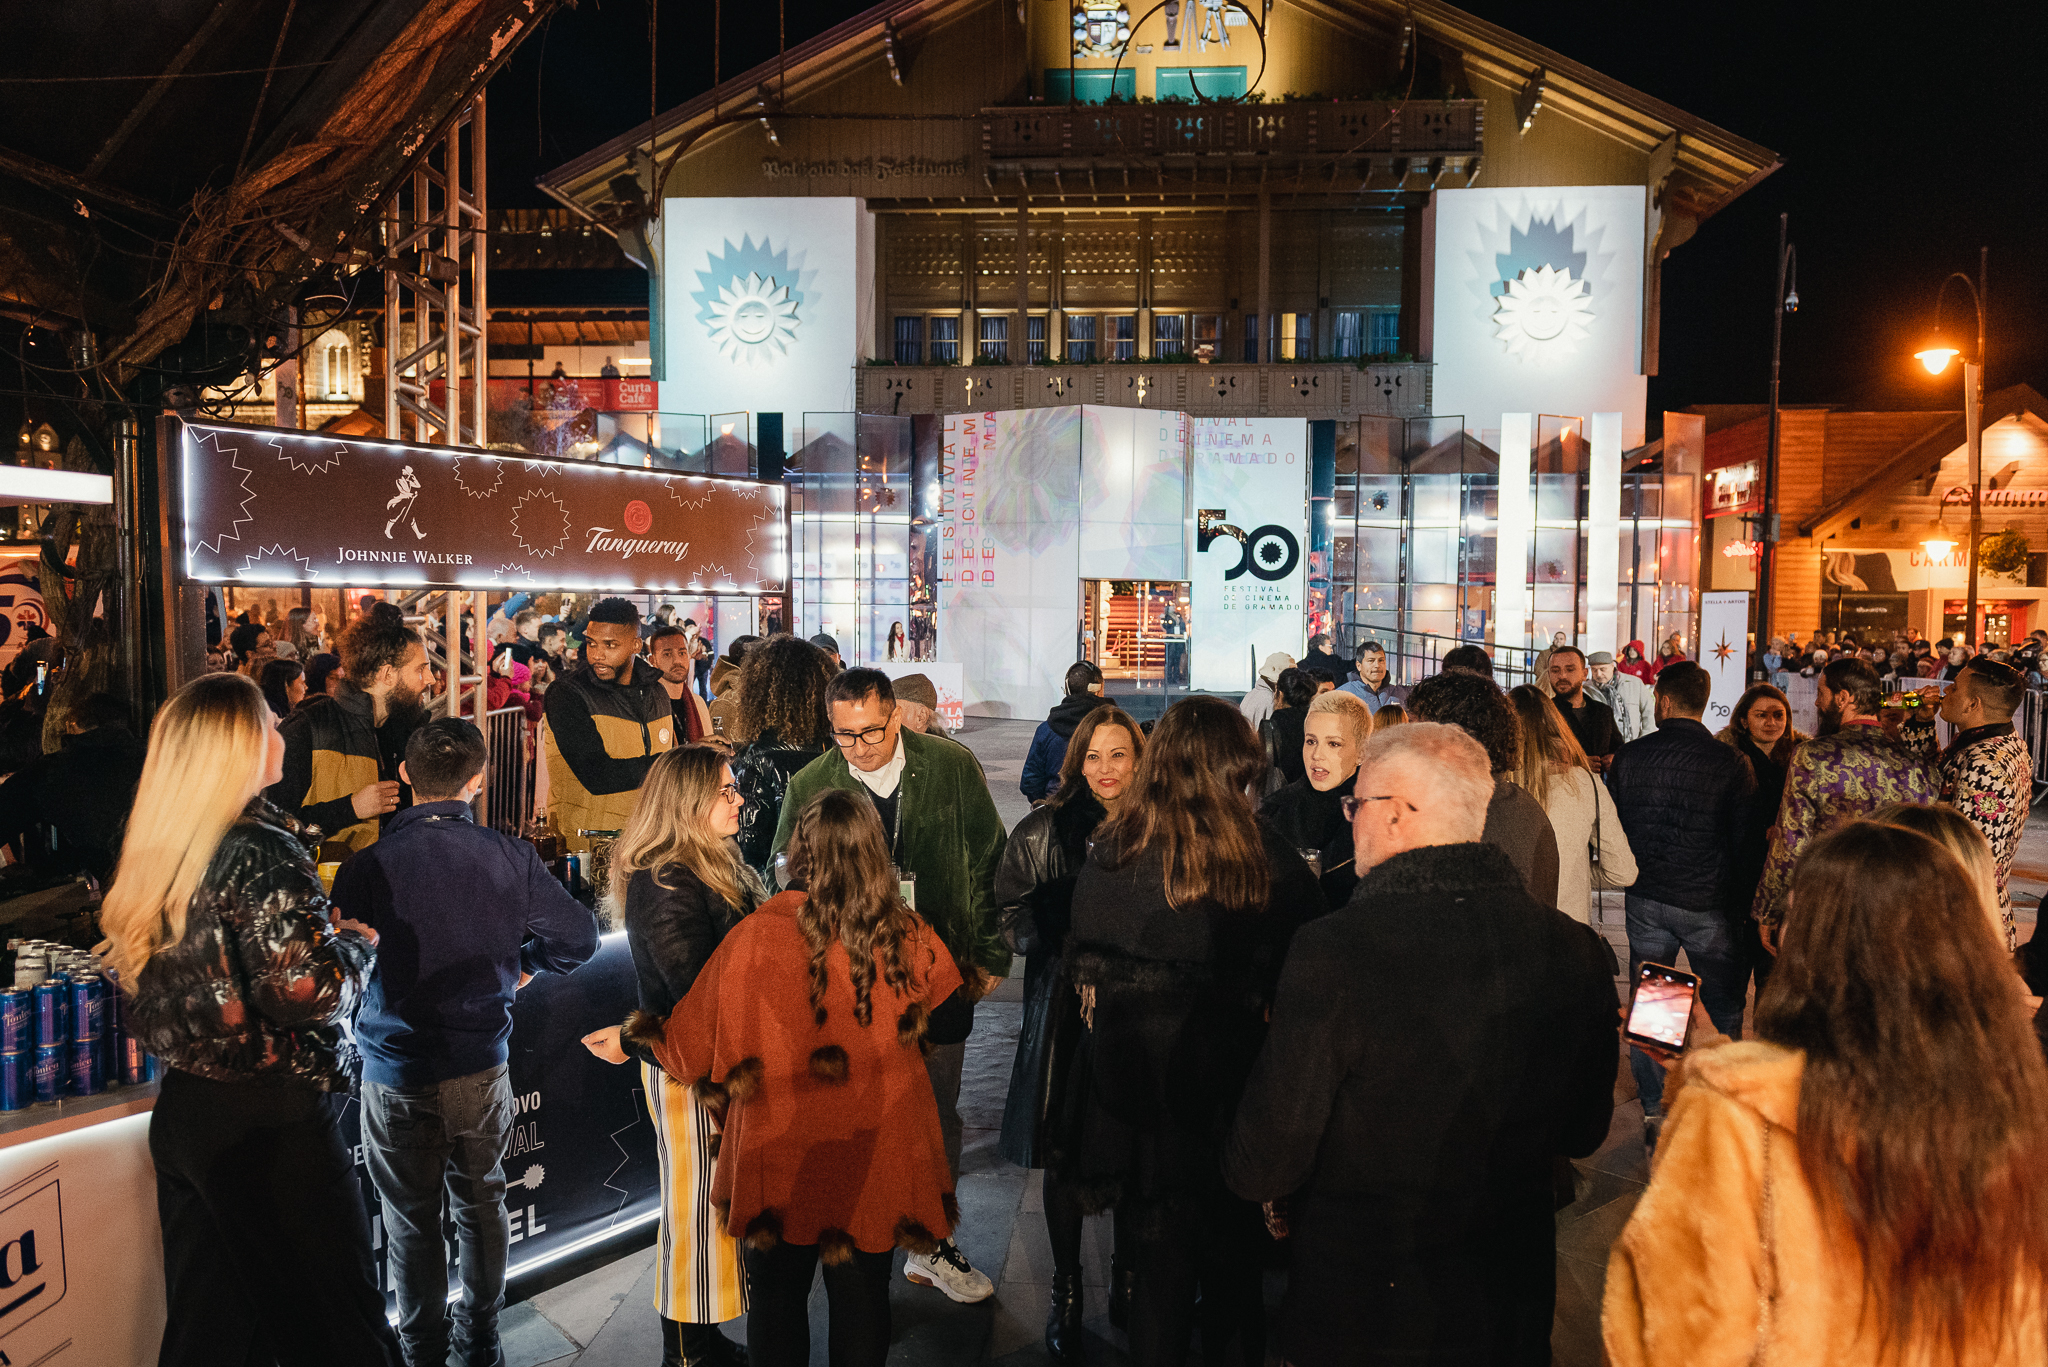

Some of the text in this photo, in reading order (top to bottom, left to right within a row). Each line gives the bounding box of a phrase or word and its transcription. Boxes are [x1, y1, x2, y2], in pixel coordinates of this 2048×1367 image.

[618, 382, 652, 394] Curta
[618, 392, 646, 404] Café
[585, 527, 690, 562] Tanqueray
[1197, 509, 1300, 582] 50
[336, 547, 473, 565] JOHNNIE WALKER
